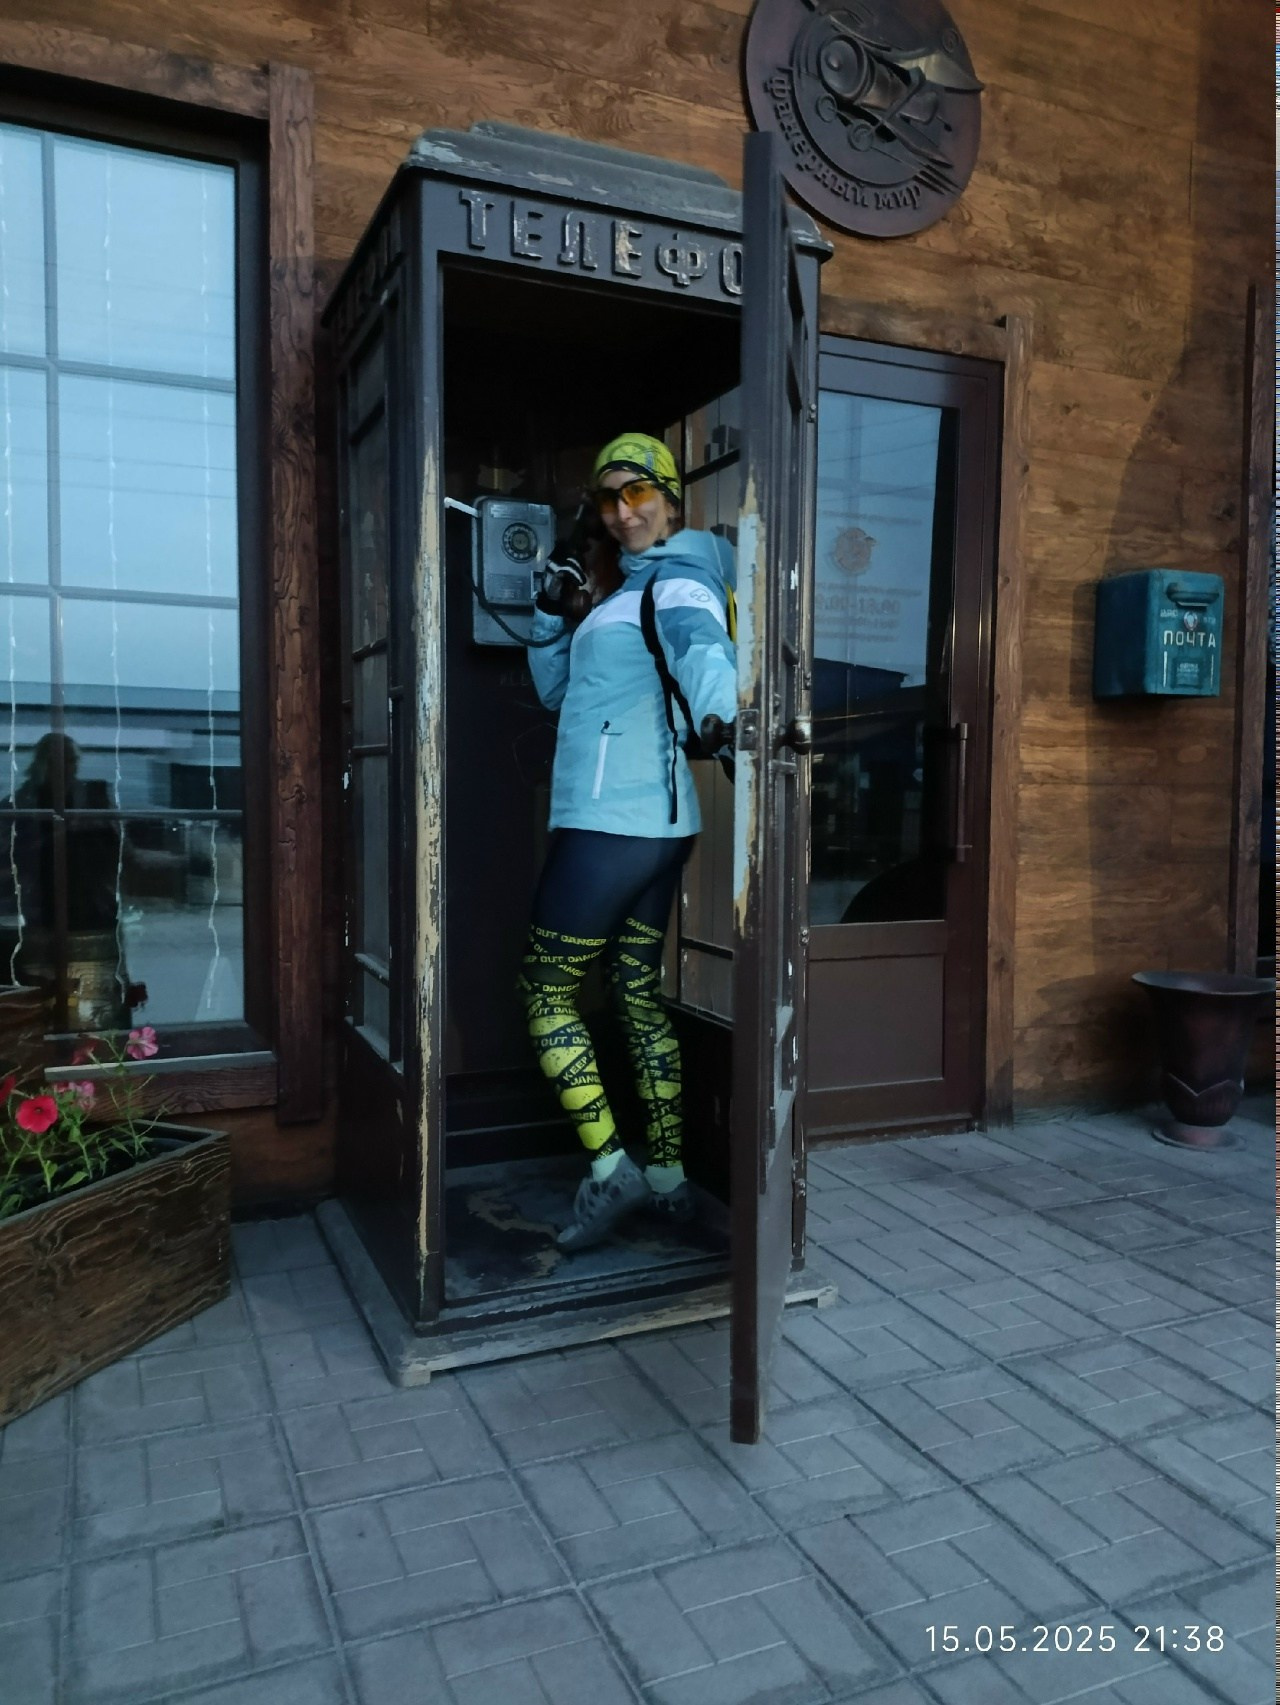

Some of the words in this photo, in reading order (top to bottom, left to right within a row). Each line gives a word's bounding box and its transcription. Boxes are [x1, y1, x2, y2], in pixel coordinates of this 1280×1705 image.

[459, 187, 743, 297] ТЕЛЕФО
[1163, 630, 1216, 648] ПОЧТА
[535, 927, 558, 939] OUT
[560, 935, 607, 946] DANGER
[540, 955, 564, 963] OUT
[542, 983, 580, 992] DANG
[541, 1036, 567, 1047] OUT
[562, 1056, 588, 1082] KEEP
